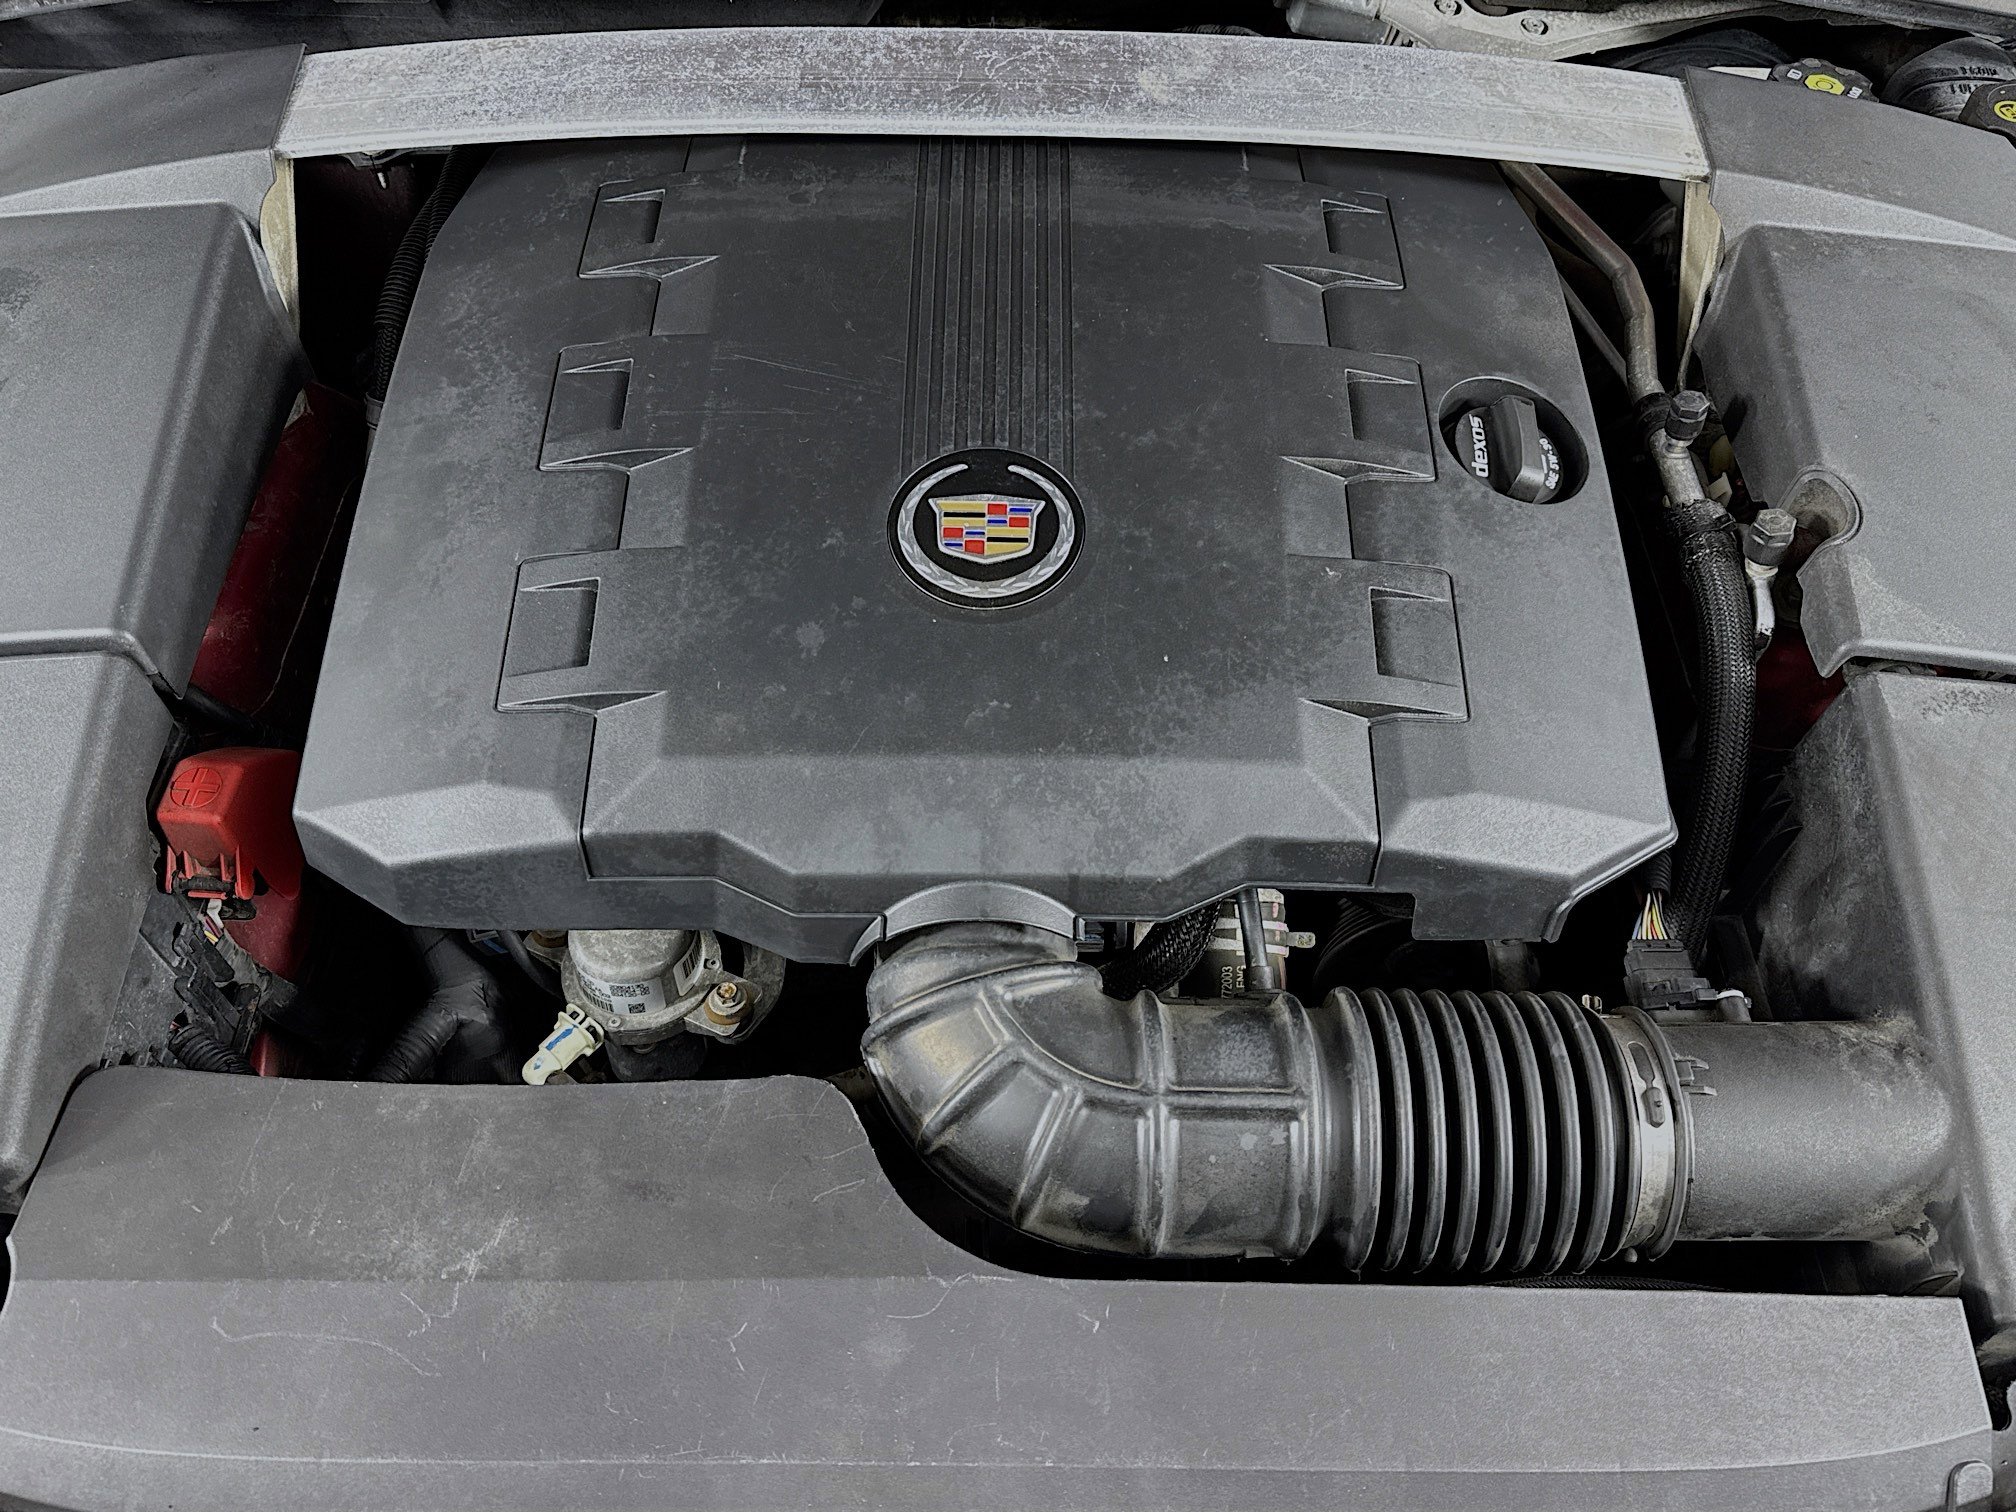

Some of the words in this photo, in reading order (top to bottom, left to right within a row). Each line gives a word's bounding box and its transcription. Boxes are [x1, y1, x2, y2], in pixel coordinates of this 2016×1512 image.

[1468, 413, 1489, 478] dexos
[1539, 437, 1560, 470] 5W-30
[1545, 470, 1560, 490] SAE
